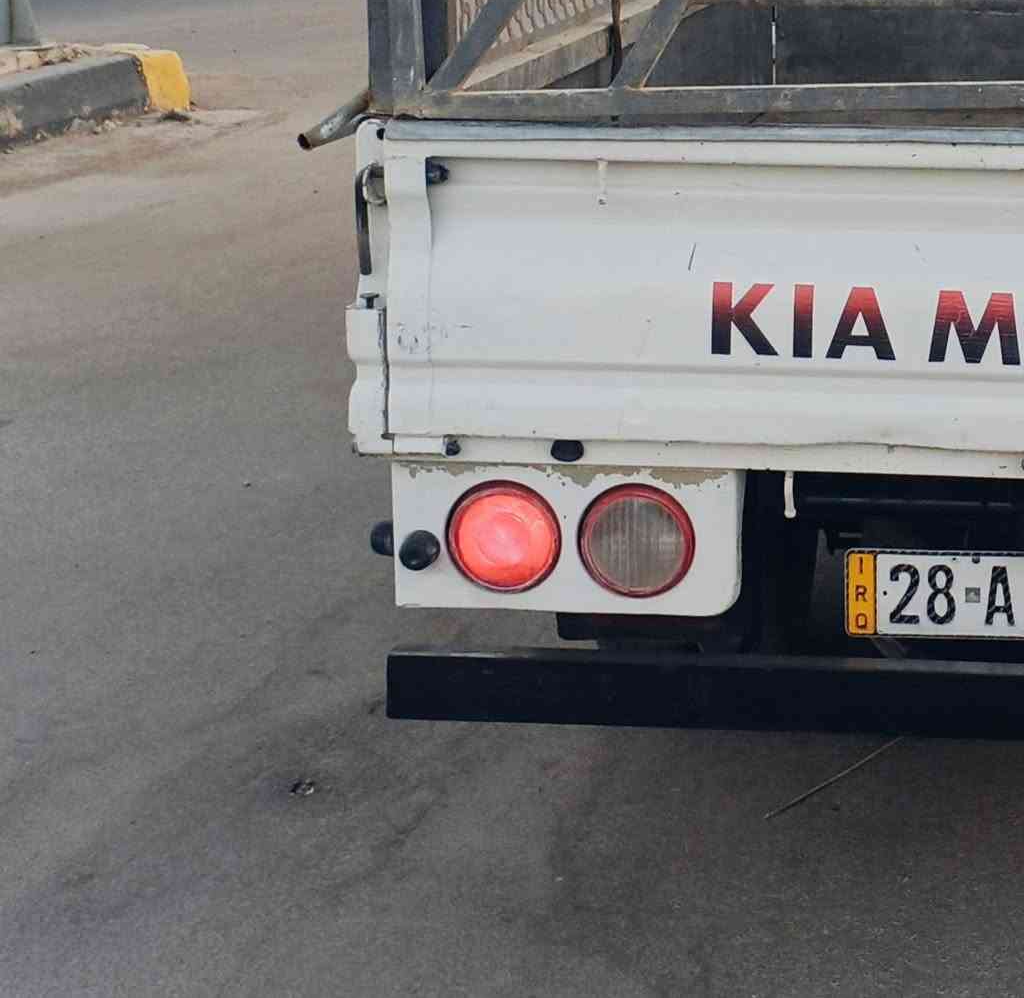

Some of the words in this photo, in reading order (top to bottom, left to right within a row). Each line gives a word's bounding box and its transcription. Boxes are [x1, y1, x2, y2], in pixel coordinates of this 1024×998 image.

[710, 282, 896, 360] KIA
[855, 556, 868, 629] IRQ
[889, 564, 957, 625] 28
[984, 566, 1015, 626] A
